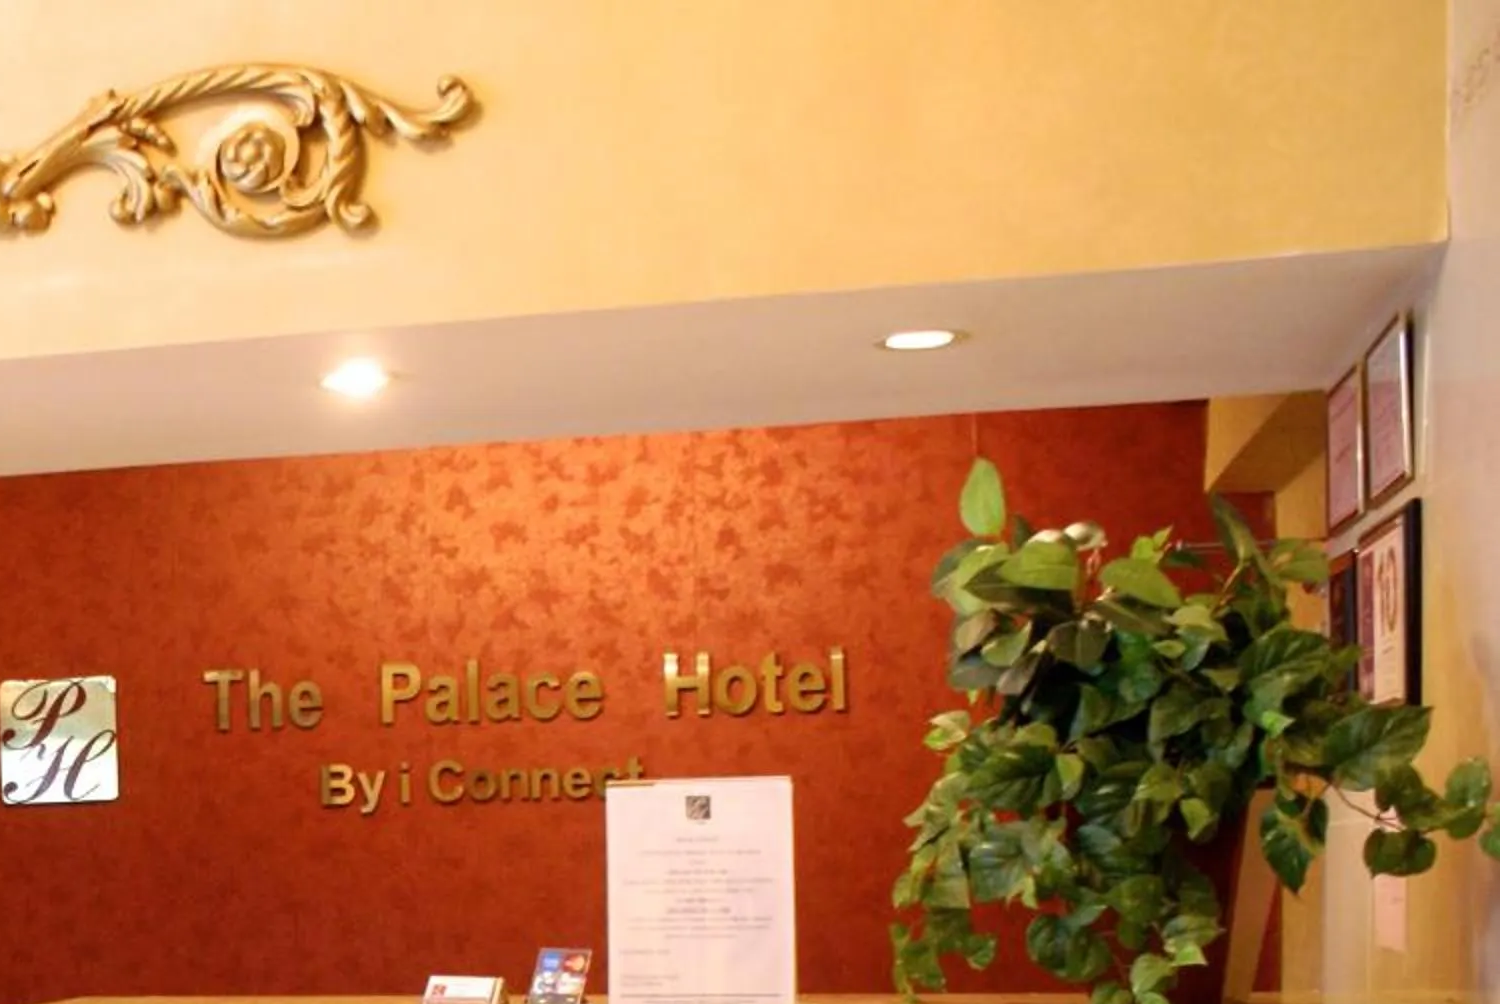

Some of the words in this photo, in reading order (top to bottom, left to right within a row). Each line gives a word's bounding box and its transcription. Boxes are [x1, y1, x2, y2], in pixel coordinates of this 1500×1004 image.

[203, 668, 324, 731] The
[379, 659, 604, 725] Palace
[662, 648, 846, 717] Hotel
[321, 763, 385, 814] By
[400, 762, 411, 804] i
